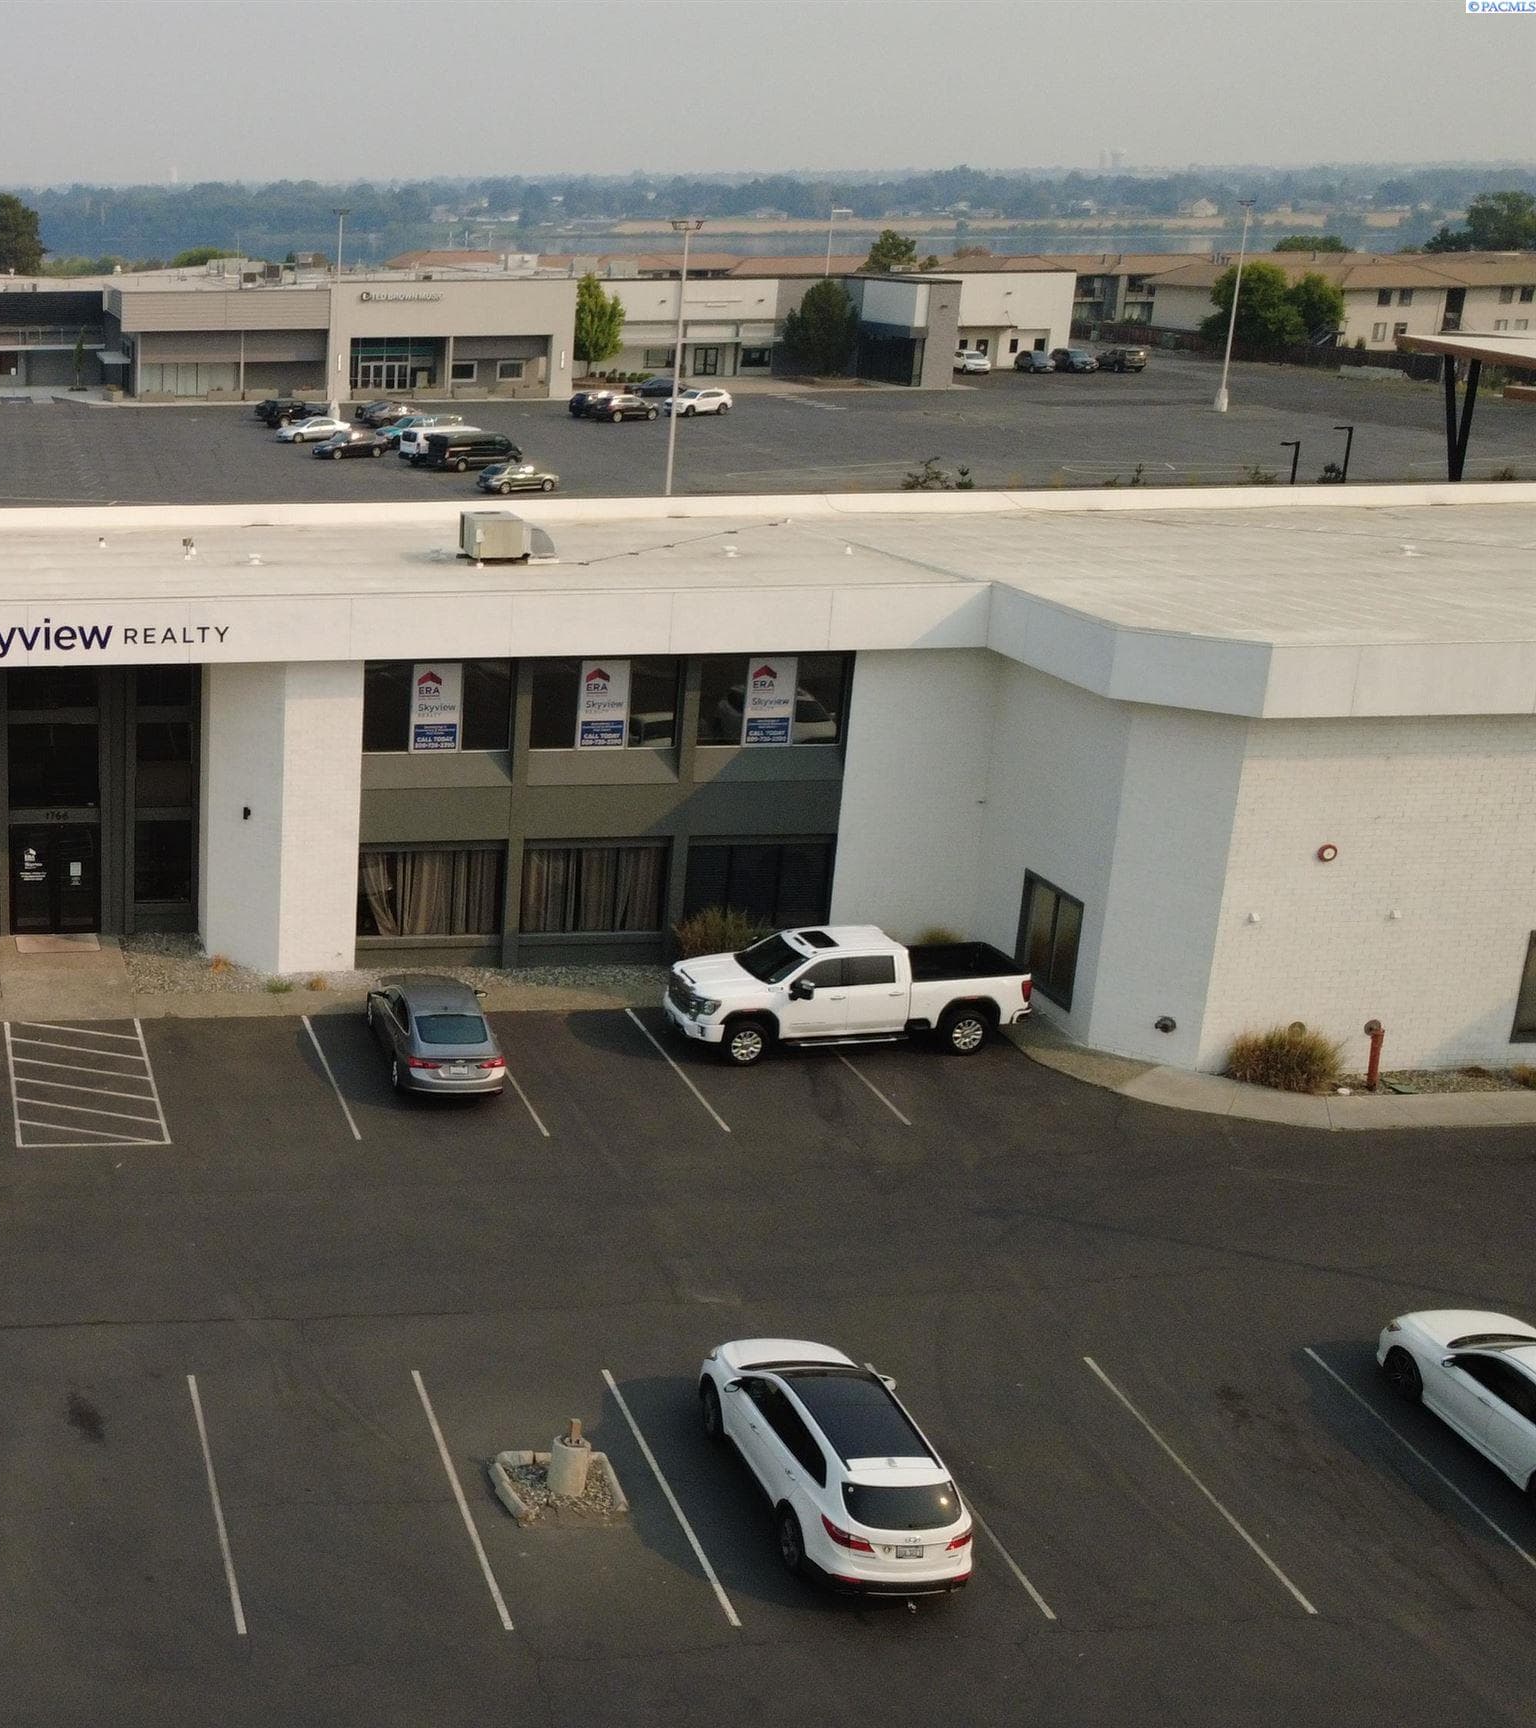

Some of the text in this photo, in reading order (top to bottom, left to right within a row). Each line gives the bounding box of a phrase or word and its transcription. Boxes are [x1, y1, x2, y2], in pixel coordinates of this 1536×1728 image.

[124, 626, 230, 645] REALTY
[586, 683, 608, 692] ERA
[753, 680, 775, 689] ERA
[418, 687, 440, 695] ERA
[418, 704, 456, 713] Skyview
